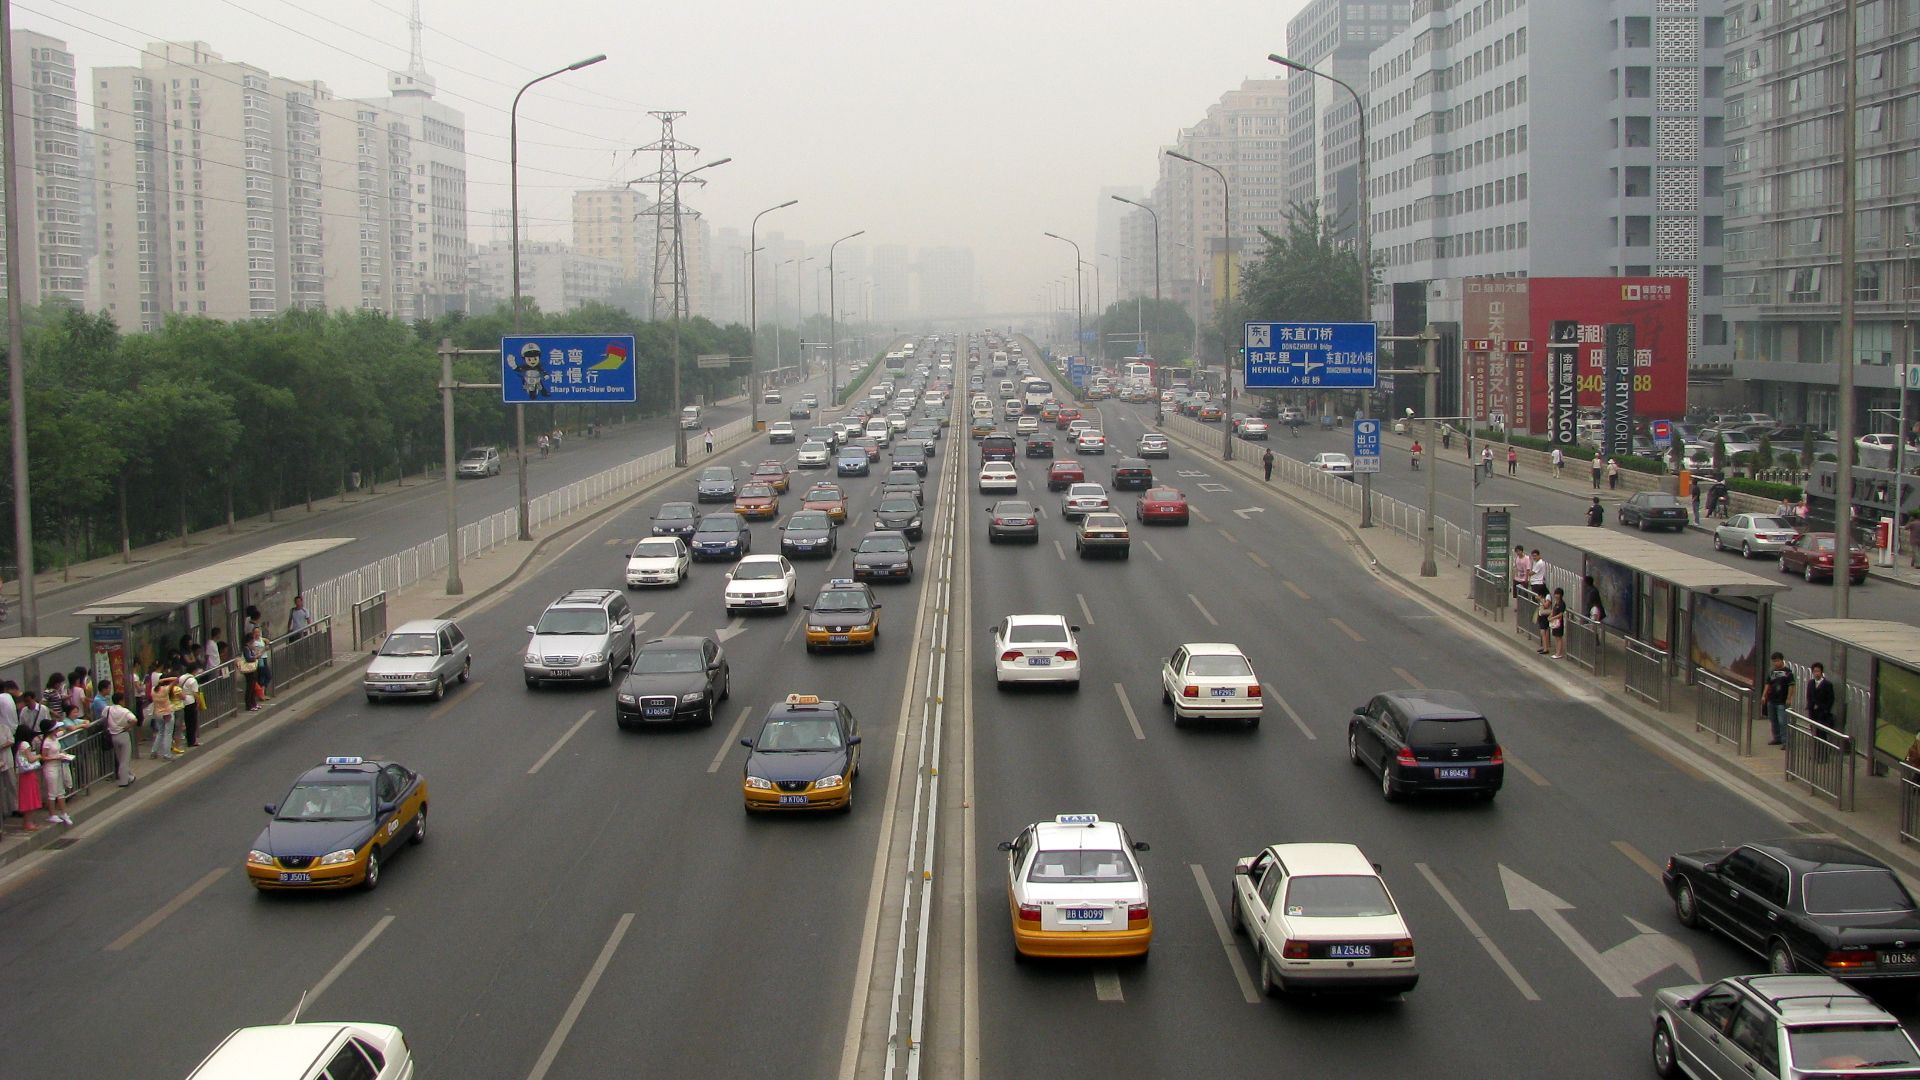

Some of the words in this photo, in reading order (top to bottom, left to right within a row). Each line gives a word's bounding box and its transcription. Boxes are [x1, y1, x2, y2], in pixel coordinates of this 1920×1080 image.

[1280, 327, 1333, 341] 东直门桥
[549, 348, 583, 365] 急弯
[1250, 351, 1291, 364] 和平里
[1326, 352, 1373, 365] 东直门北小街
[550, 367, 599, 384] 请慢行
[1251, 366, 1290, 374] HEPINGLI
[1291, 376, 1320, 385] 小街桥
[1576, 375, 1652, 392] 84088
[550, 385, 570, 394] Sharp
[1357, 434, 1376, 444] 出口
[1078, 909, 1103, 919] L8099
[1344, 945, 1371, 955] Z5465
